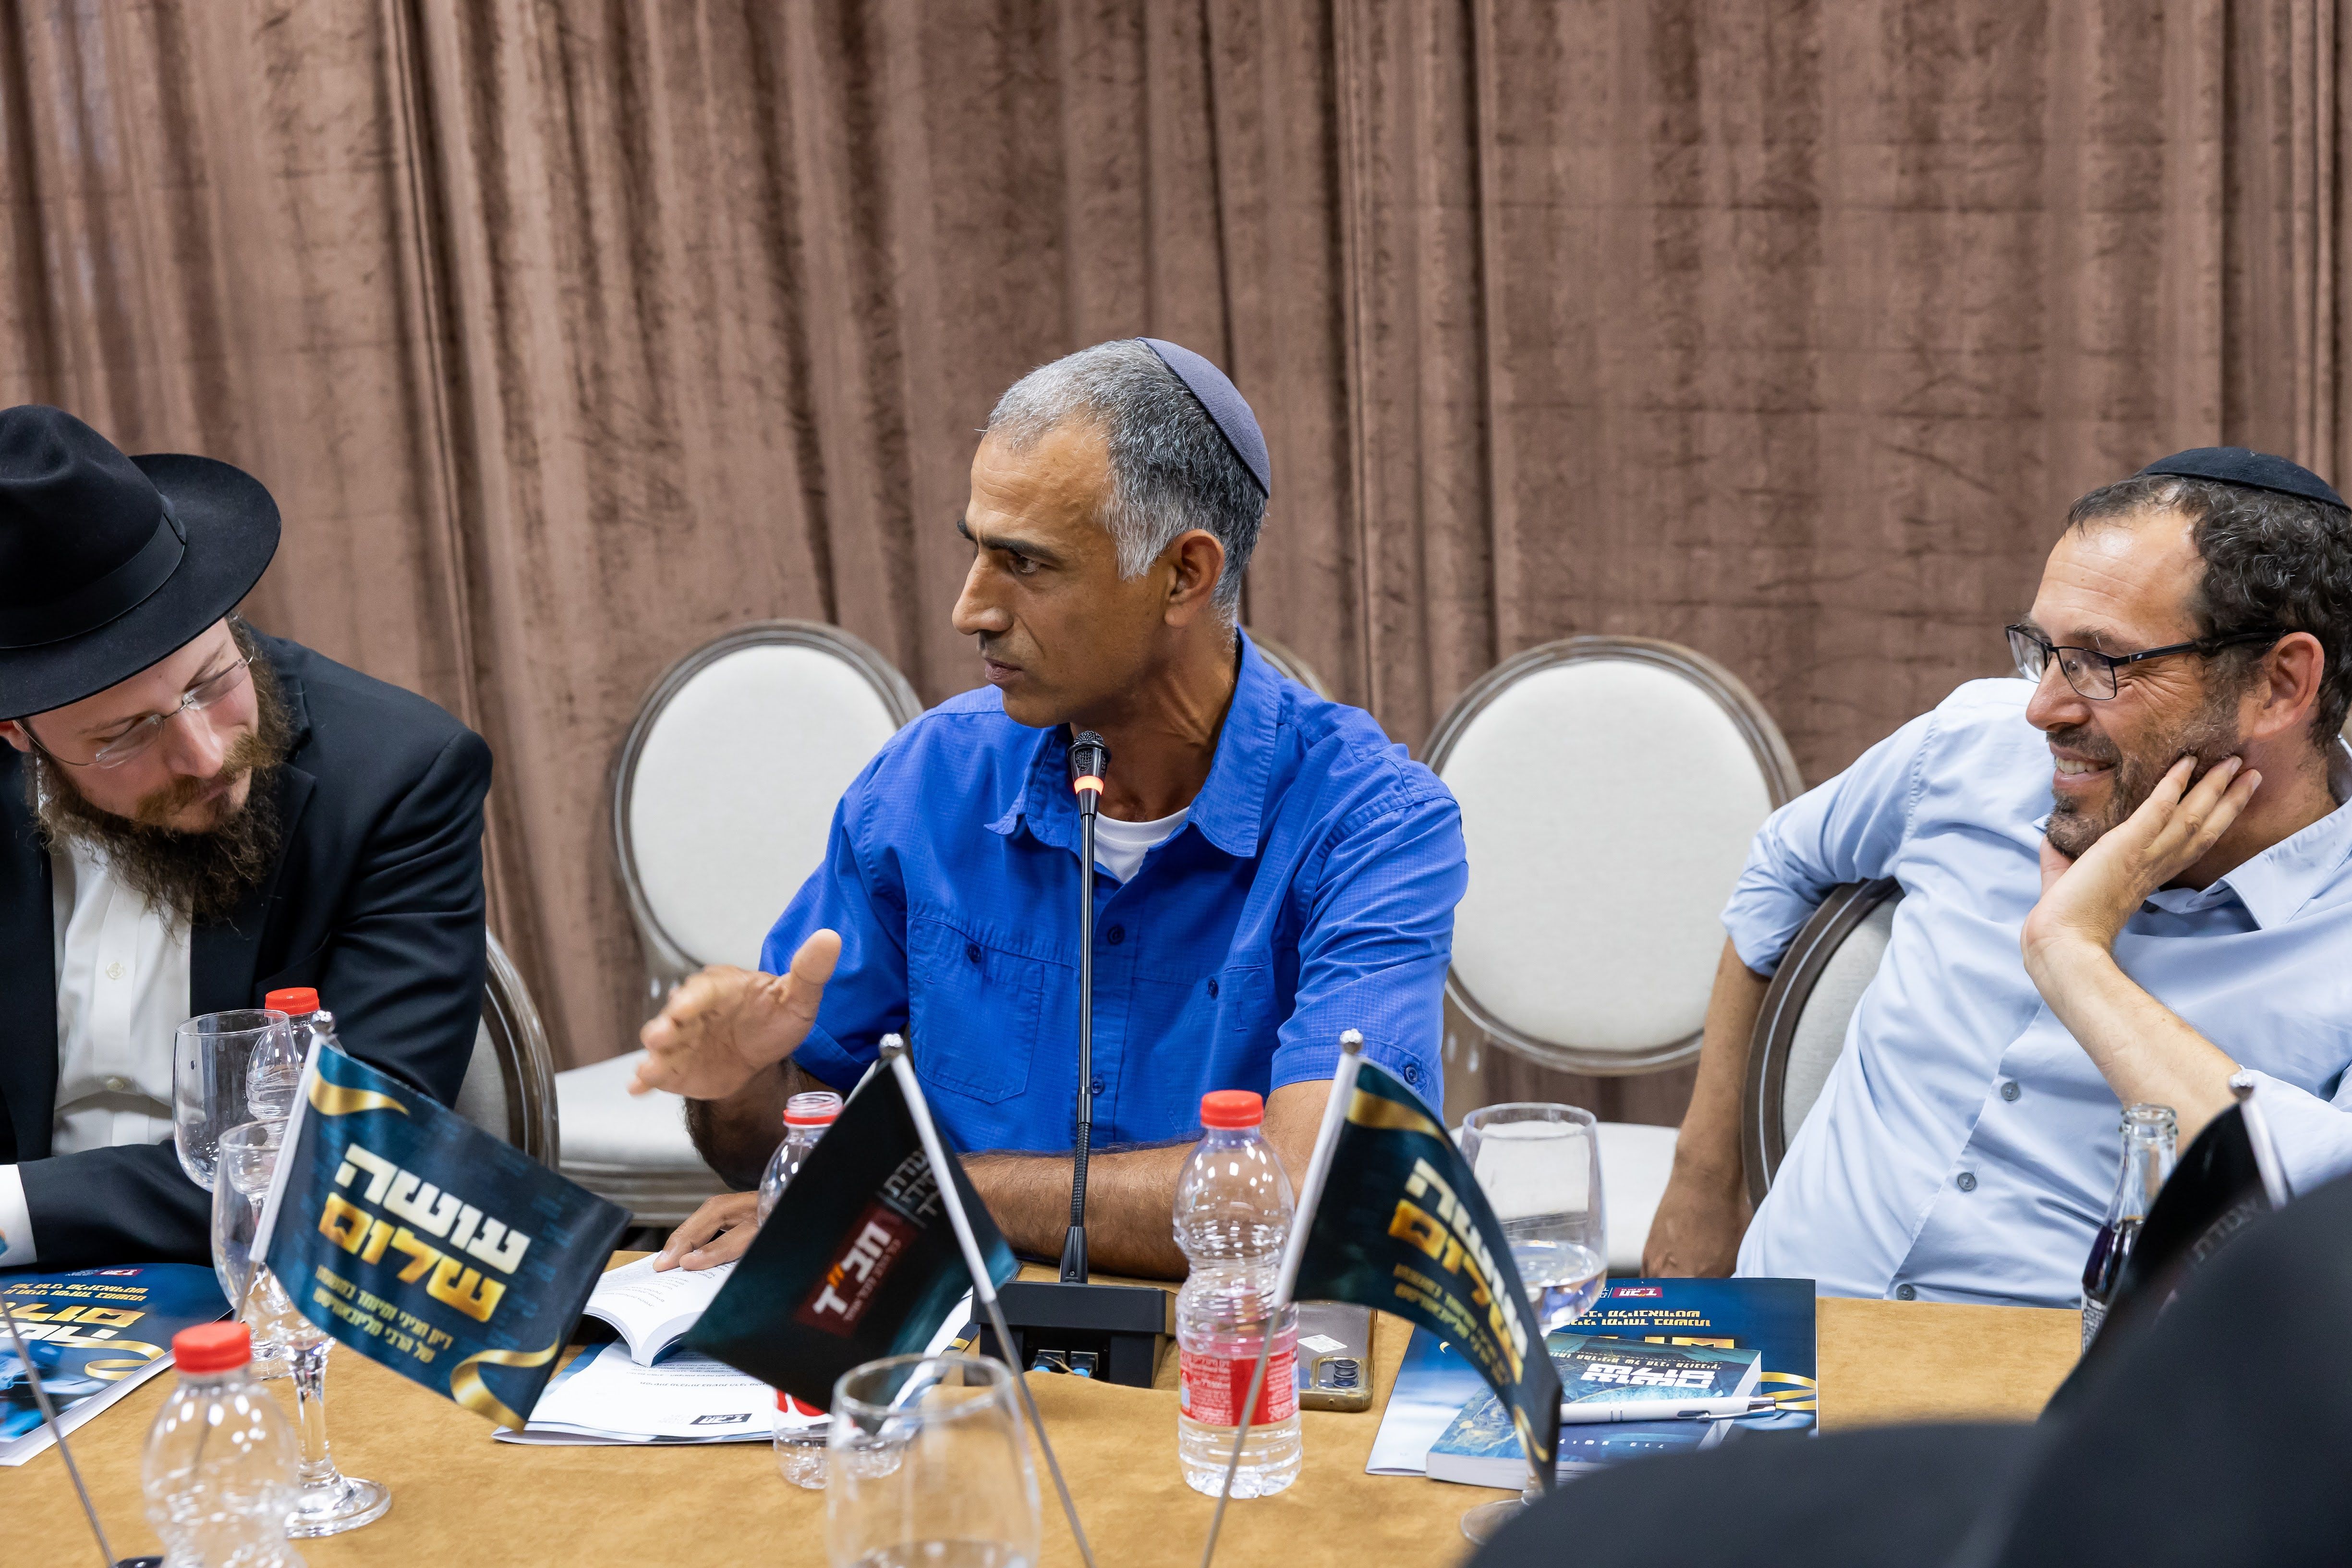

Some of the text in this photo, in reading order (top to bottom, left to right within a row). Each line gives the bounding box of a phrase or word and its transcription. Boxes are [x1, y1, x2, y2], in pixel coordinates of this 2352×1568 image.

[334, 1143, 532, 1275] עושה
[318, 1191, 507, 1323] שלום
[812, 1220, 893, 1318] חב"ד
[94, 1292, 148, 1302] במשנתו
[0, 1301, 145, 1328] לום
[1654, 1318, 1711, 1327] במשנתו
[1580, 1371, 1713, 1389] עושה
[1585, 1363, 1715, 1381] שלום
